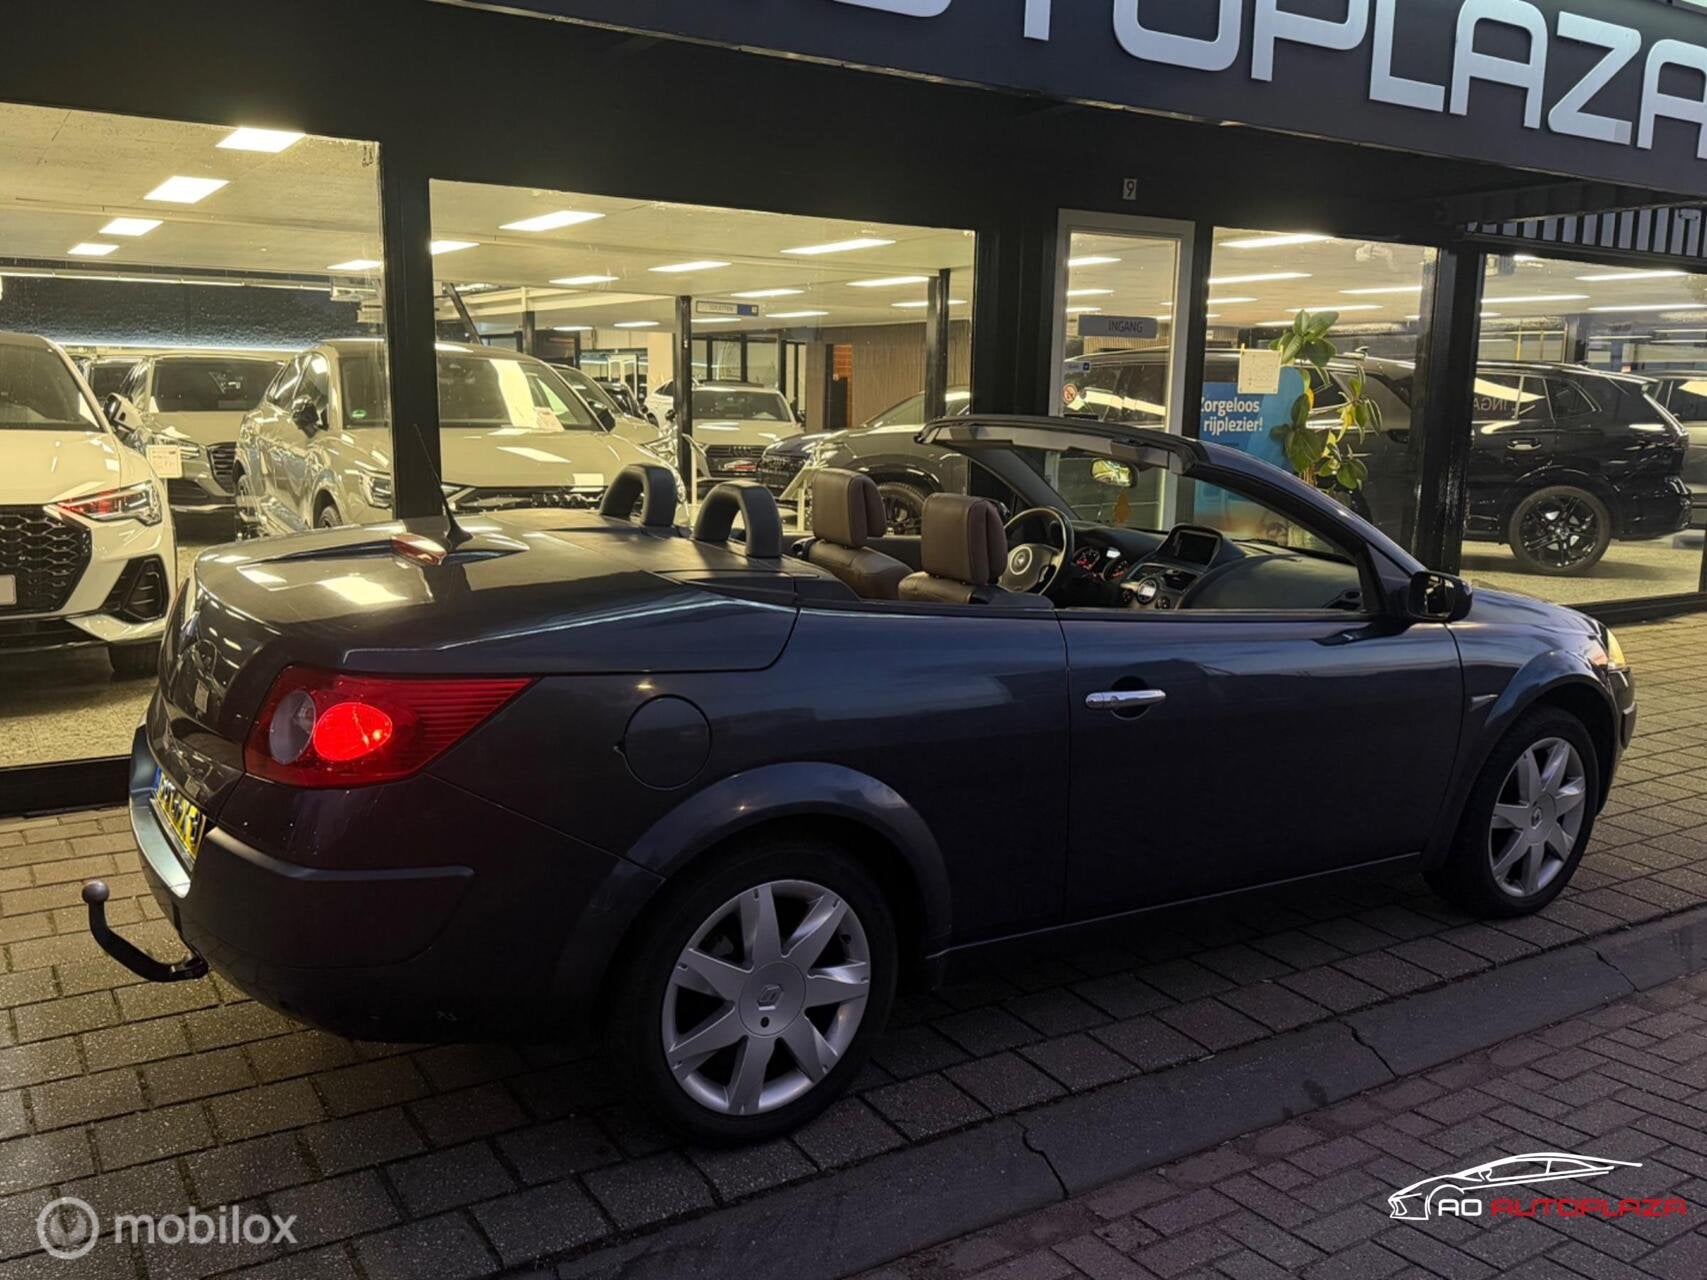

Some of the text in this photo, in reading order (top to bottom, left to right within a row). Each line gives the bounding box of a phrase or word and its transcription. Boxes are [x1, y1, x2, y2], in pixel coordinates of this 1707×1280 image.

[834, 0, 1707, 160] OPLAZA
[1126, 180, 1135, 197] 9
[1107, 319, 1144, 333] INGANG
[1203, 416, 1264, 436] rijplezier!
